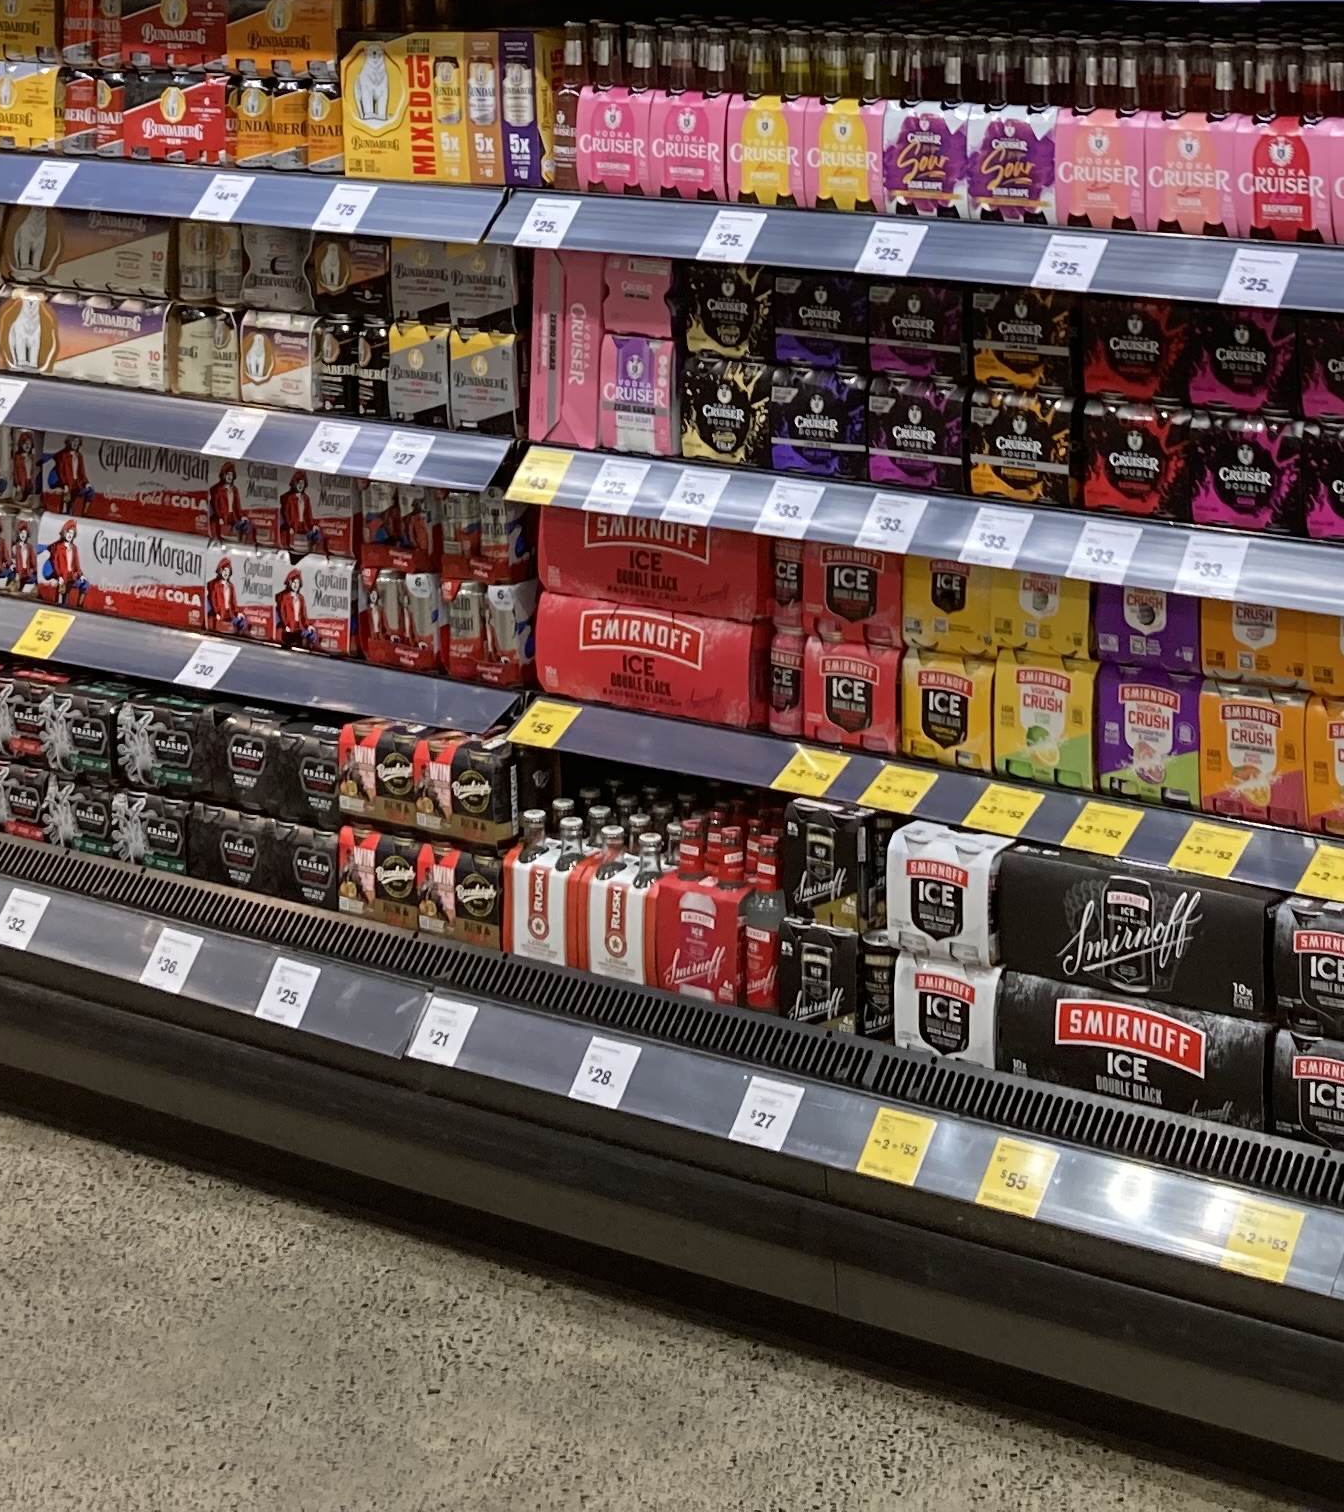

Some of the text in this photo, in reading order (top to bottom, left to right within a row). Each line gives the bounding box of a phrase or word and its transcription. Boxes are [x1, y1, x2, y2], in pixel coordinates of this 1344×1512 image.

[406, 54, 431, 89] 15
[142, 118, 203, 140] BUNDABERG
[411, 89, 437, 176] MIXED
[652, 138, 720, 162] CRUISER
[897, 144, 949, 181] Sour
[336, 203, 356, 217] $75
[81, 306, 142, 332] BUNDABERG
[603, 383, 665, 407] CRUISER
[93, 529, 203, 578] Captain Morgan
[166, 589, 201, 607] COLA
[590, 618, 693, 655] SMIRNOFF
[623, 655, 655, 677] ICE
[831, 678, 866, 701] ICE
[354, 745, 375, 765] WIN
[534, 870, 544, 912] RUSKI
[1057, 891, 1203, 976] Smirnoff
[663, 947, 726, 986] Smirnoff
[917, 975, 974, 1001] SMIRNOFF
[926, 996, 961, 1021] ICE
[429, 1030, 450, 1048] $21
[1070, 1010, 1191, 1061] SMIRNOFF
[588, 1065, 612, 1086] $28
[1107, 1052, 1149, 1081] ICE
[1096, 1074, 1162, 1105] DOUBLE BLACK
[750, 1109, 776, 1130] $27
[1001, 1171, 1028, 1191] $55
